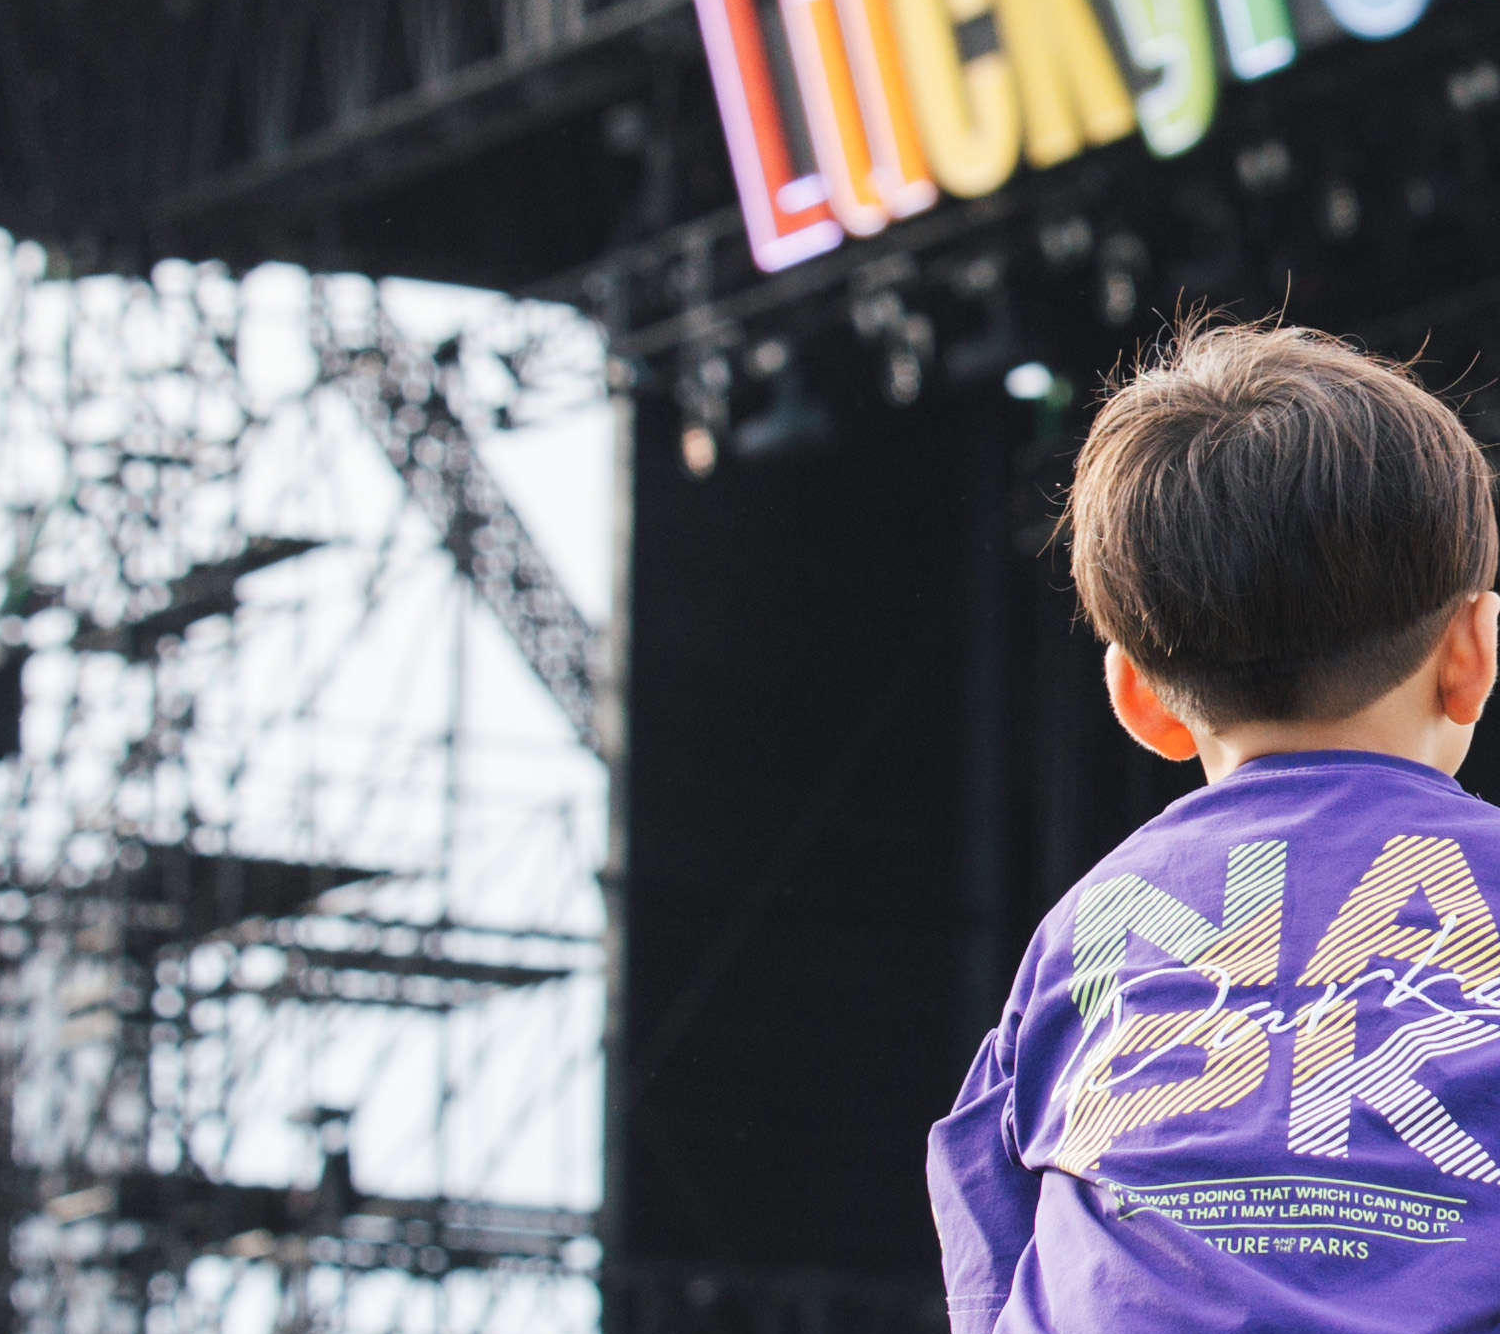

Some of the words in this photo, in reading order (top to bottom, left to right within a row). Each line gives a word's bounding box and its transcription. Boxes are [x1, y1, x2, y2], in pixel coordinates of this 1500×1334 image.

[1194, 1190, 1246, 1204] DOING
[1250, 1186, 1292, 1201] THAT
[1295, 1186, 1350, 1202] WHICH
[1354, 1192, 1359, 1204] I
[1362, 1194, 1397, 1210] CAN
[1400, 1200, 1433, 1218] NOT
[1187, 1206, 1228, 1220] THAT
[1232, 1205, 1237, 1217] I
[1241, 1205, 1276, 1217] MAY
[1279, 1204, 1335, 1217] LEARN
[1339, 1207, 1378, 1223] HOW
[1382, 1213, 1404, 1228] TO
[1406, 1218, 1430, 1233] DO
[1432, 1222, 1450, 1233] IT.
[1273, 1237, 1297, 1245] AND
[1299, 1237, 1369, 1259] PARKS
